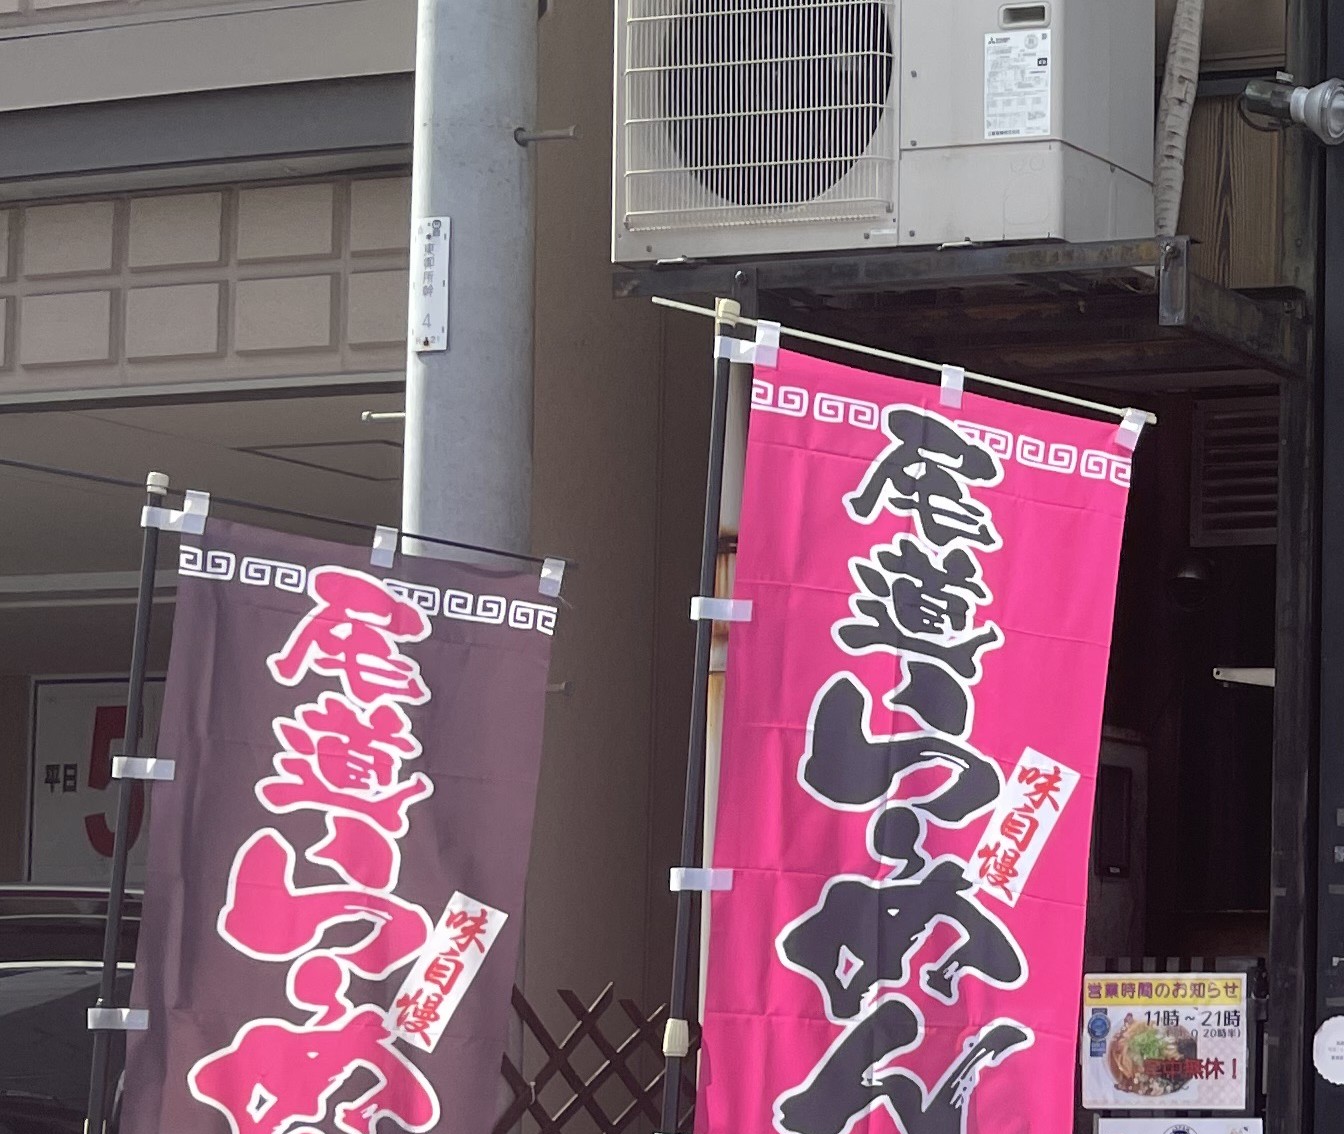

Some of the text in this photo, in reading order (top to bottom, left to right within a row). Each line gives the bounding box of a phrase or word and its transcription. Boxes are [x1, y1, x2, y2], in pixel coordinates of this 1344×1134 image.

[422, 312, 432, 328] 4
[978, 766, 1064, 901] 味自慢
[396, 908, 489, 1046] 味自慢
[1087, 981, 1240, 1000] 営業時間のお知らせ
